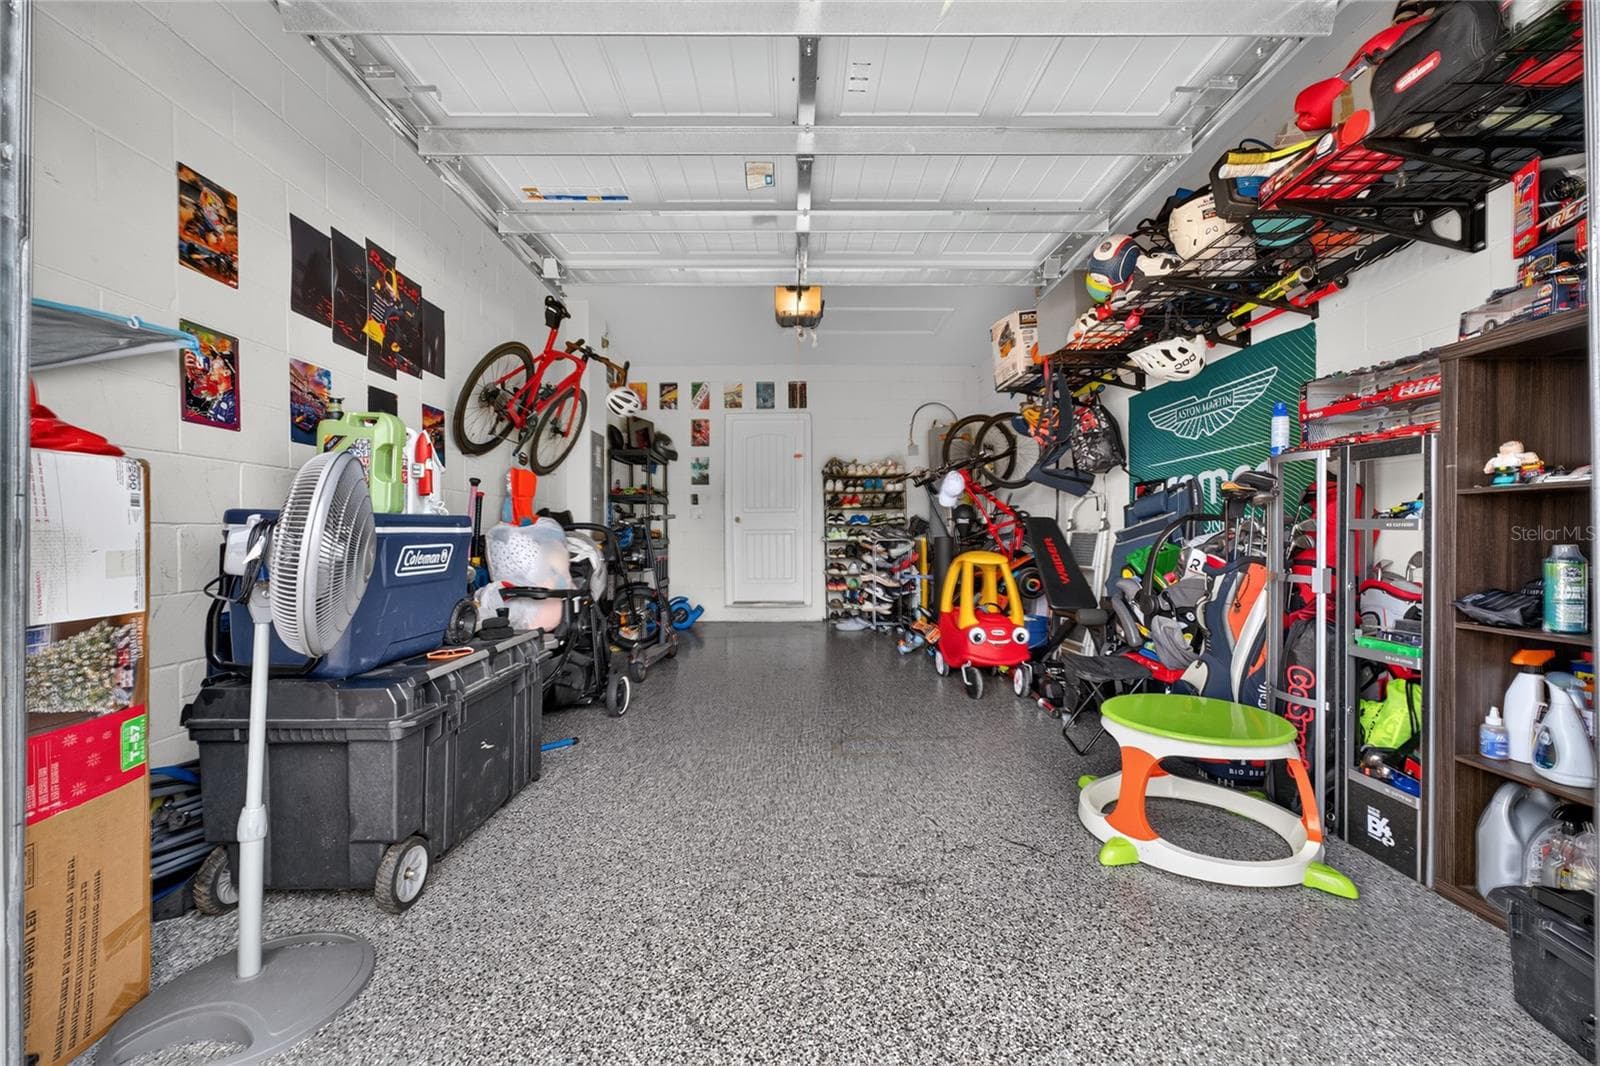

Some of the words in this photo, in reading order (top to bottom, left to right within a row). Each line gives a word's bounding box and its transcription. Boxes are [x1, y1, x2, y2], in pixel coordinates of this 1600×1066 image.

[1174, 352, 1197, 371] POC
[1178, 407, 1201, 420] ASTON
[1201, 393, 1233, 413] MARTIN
[403, 549, 441, 567] Coleman
[52, 977, 69, 1062] MANUFACTURED
[61, 961, 70, 976] BY
